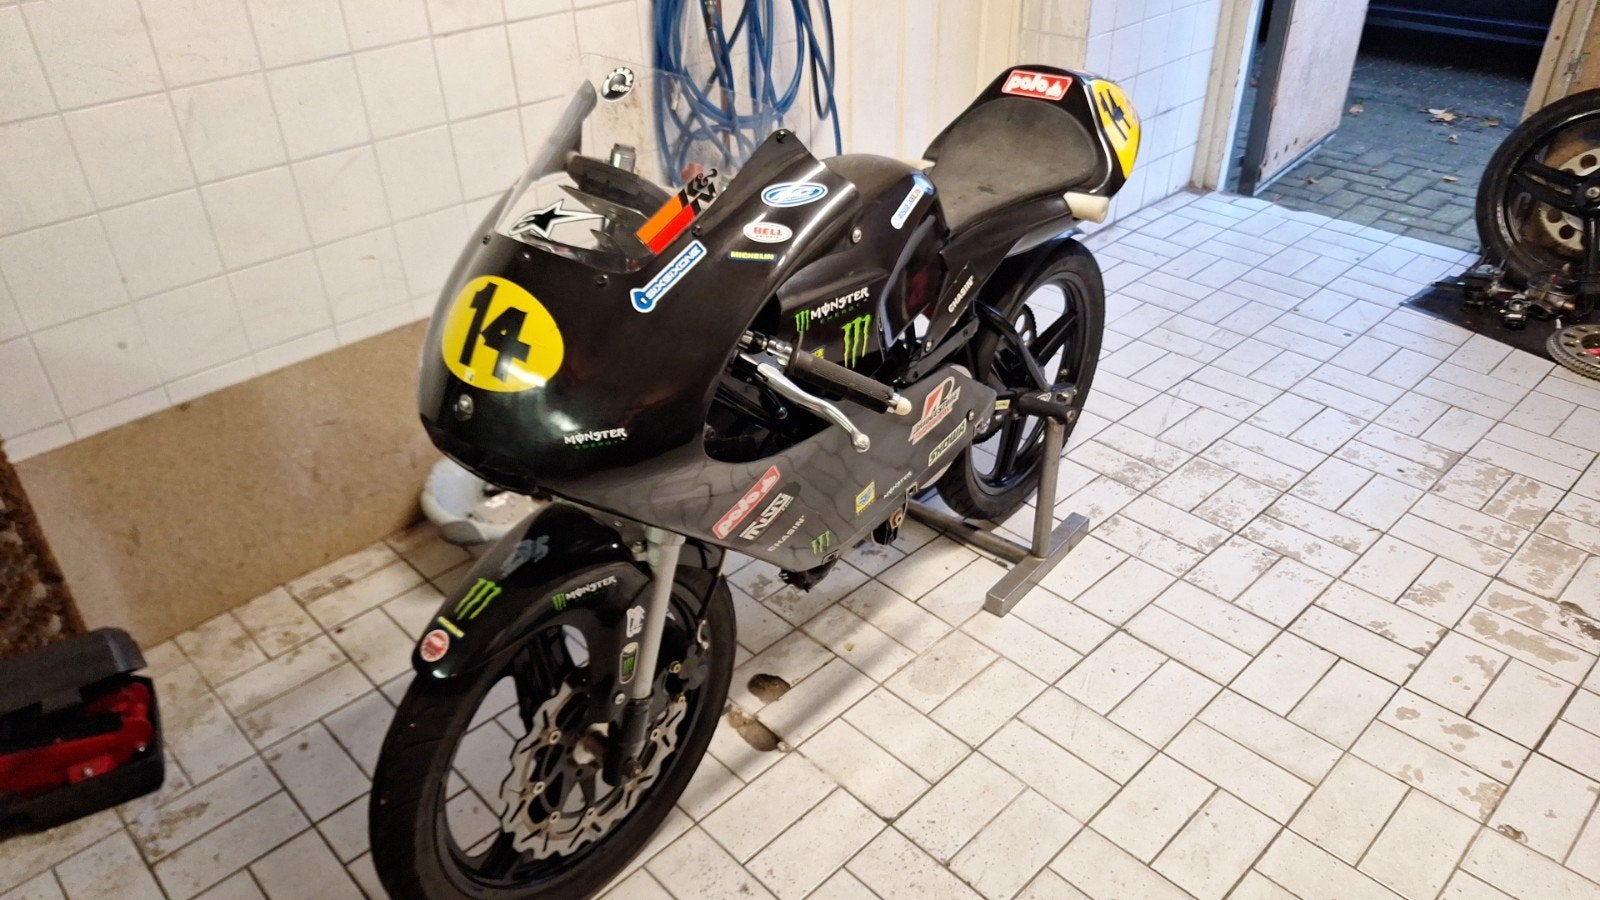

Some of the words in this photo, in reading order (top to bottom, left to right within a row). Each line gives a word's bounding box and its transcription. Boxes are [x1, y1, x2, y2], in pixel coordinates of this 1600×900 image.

[1005, 73, 1048, 93] polo
[753, 227, 783, 236] BELL
[730, 250, 775, 260] MICHELIN
[645, 245, 702, 300] SIXSIXONE
[810, 287, 870, 320] MONSTER
[459, 281, 531, 382] 14
[563, 427, 628, 445] MONSTER
[717, 491, 761, 539] polo
[565, 576, 617, 600] MONSTER
